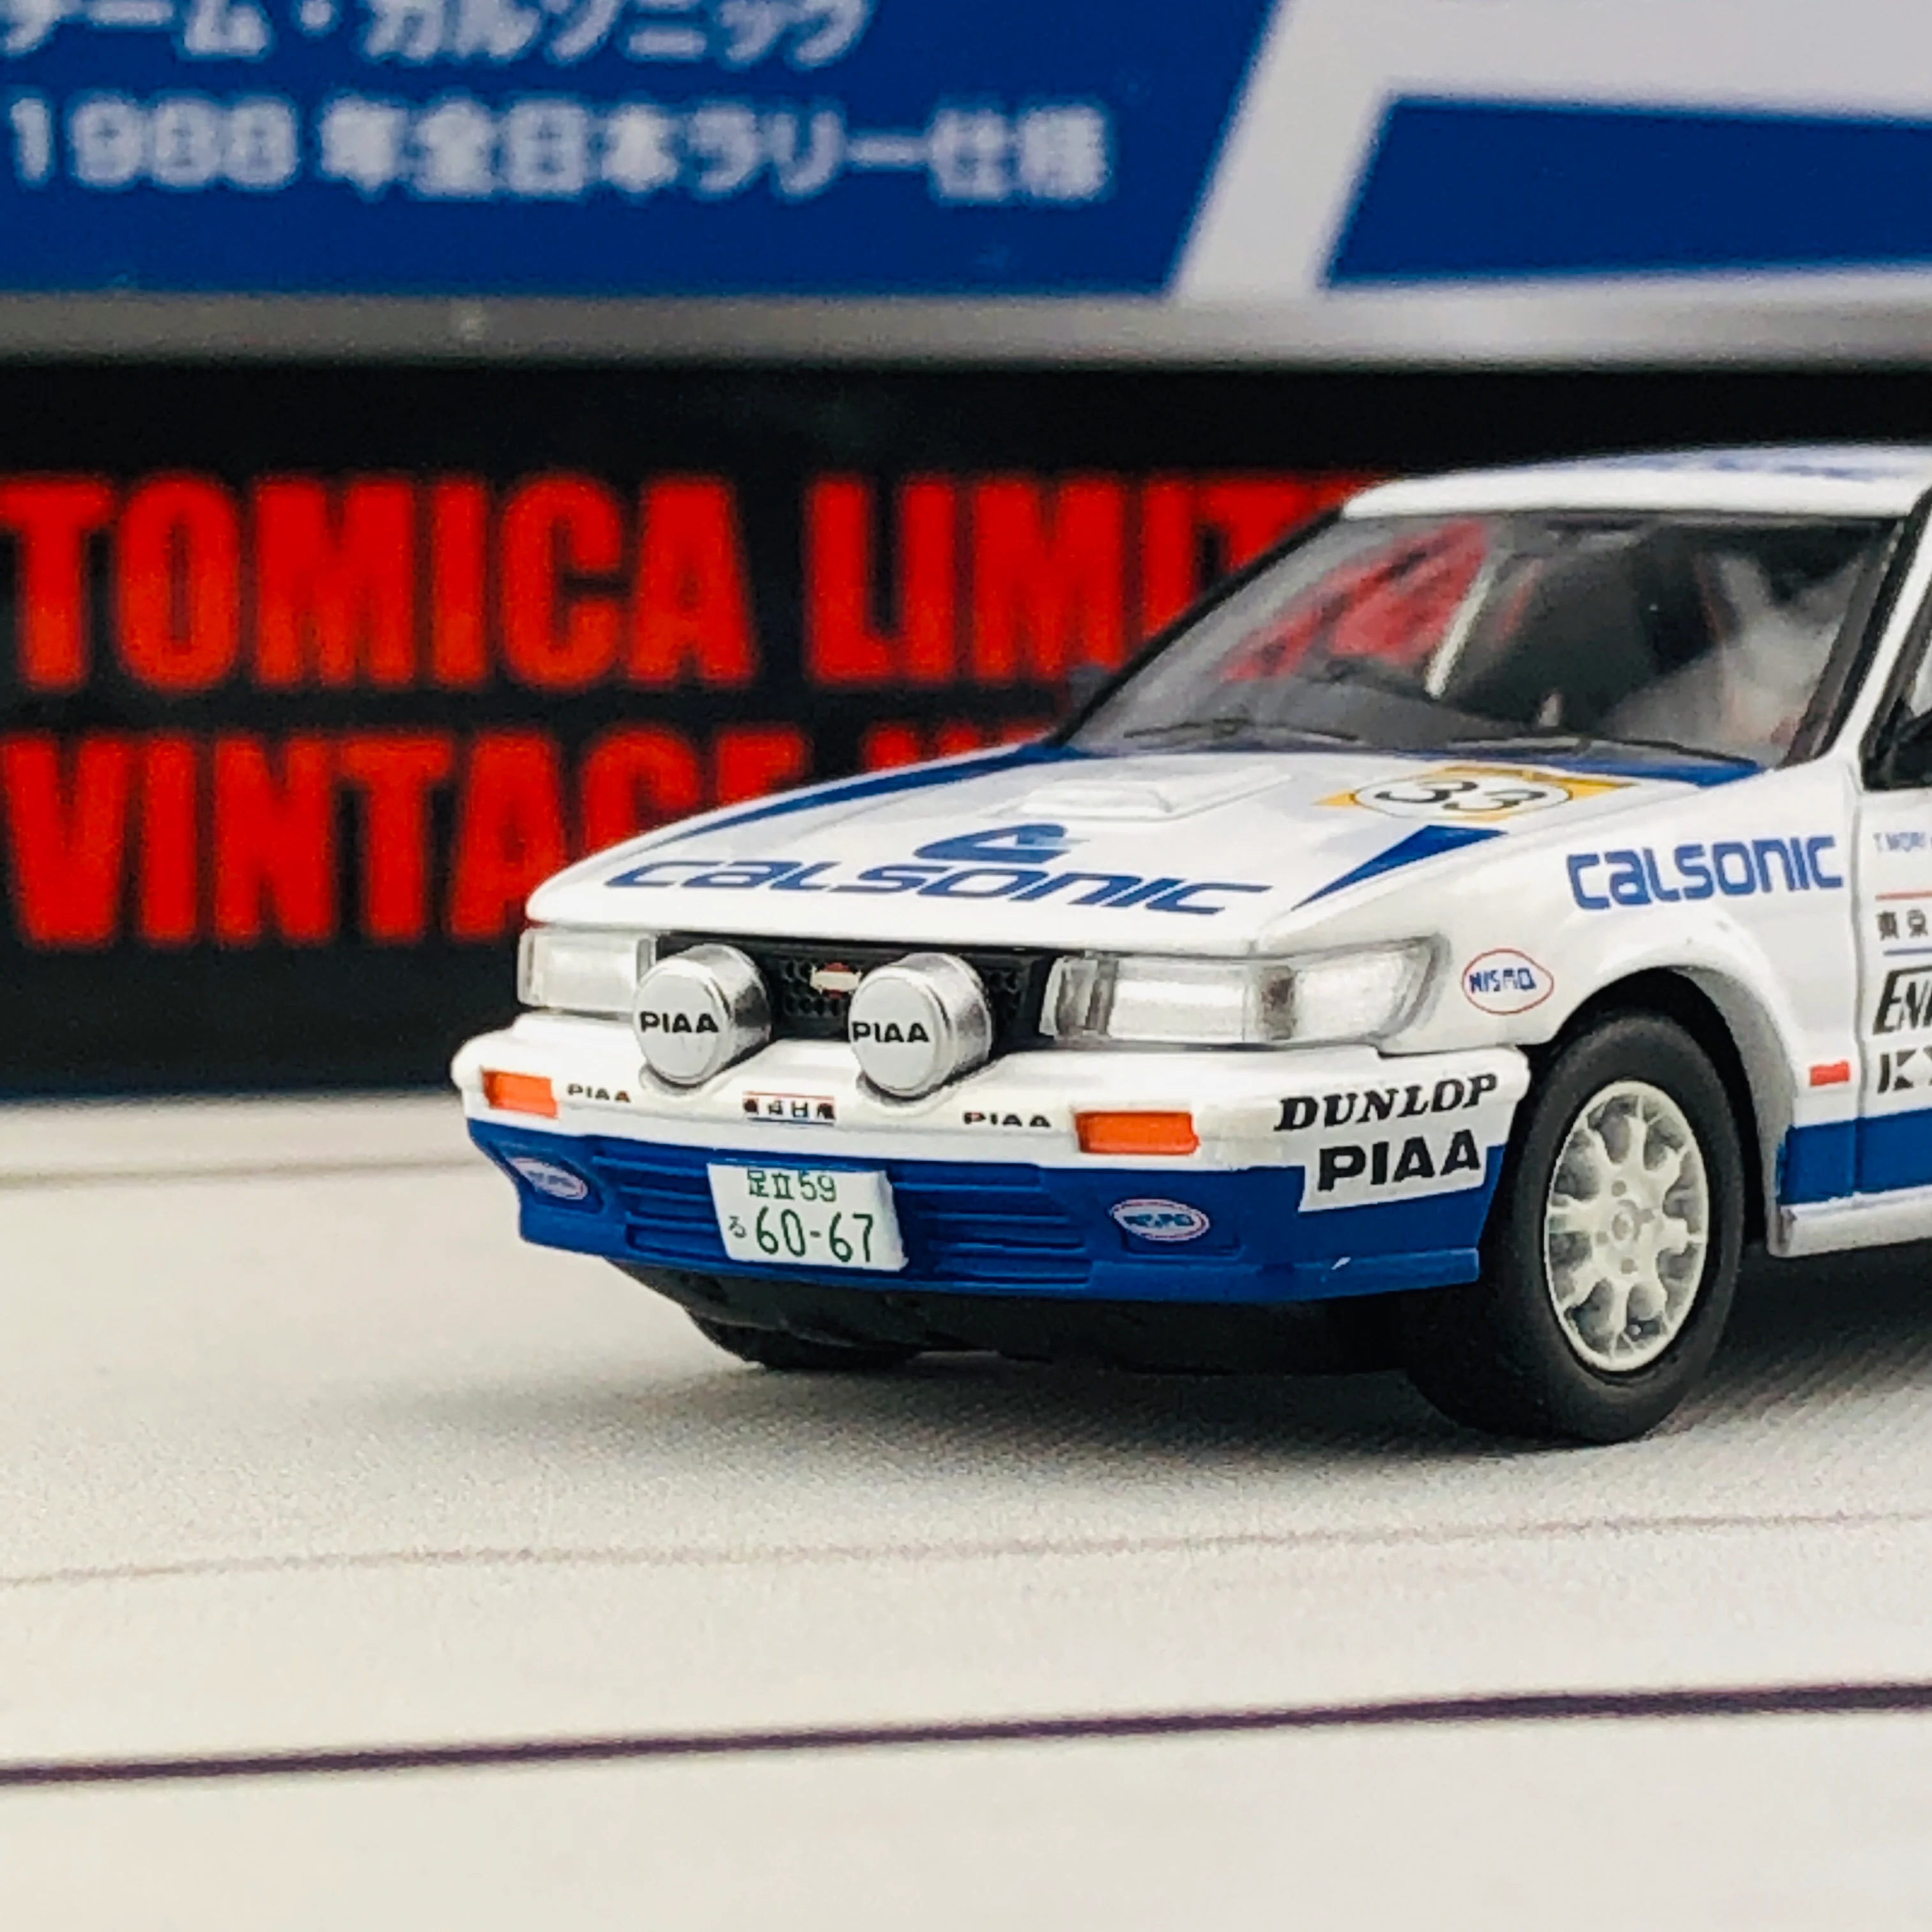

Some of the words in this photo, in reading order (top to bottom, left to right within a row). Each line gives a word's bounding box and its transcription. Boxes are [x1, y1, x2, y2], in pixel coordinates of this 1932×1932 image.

[0, 476, 754, 687] TOMICA
[1374, 780, 1549, 811] 33
[639, 1011, 719, 1034] PIAA
[851, 1022, 931, 1043] PIAA
[567, 1082, 632, 1103] PIAA
[1273, 1073, 1498, 1131] DUNLOP
[963, 1112, 1052, 1128] PIAA
[1317, 1129, 1481, 1192] PIAA
[755, 1205, 875, 1263] 60-67
